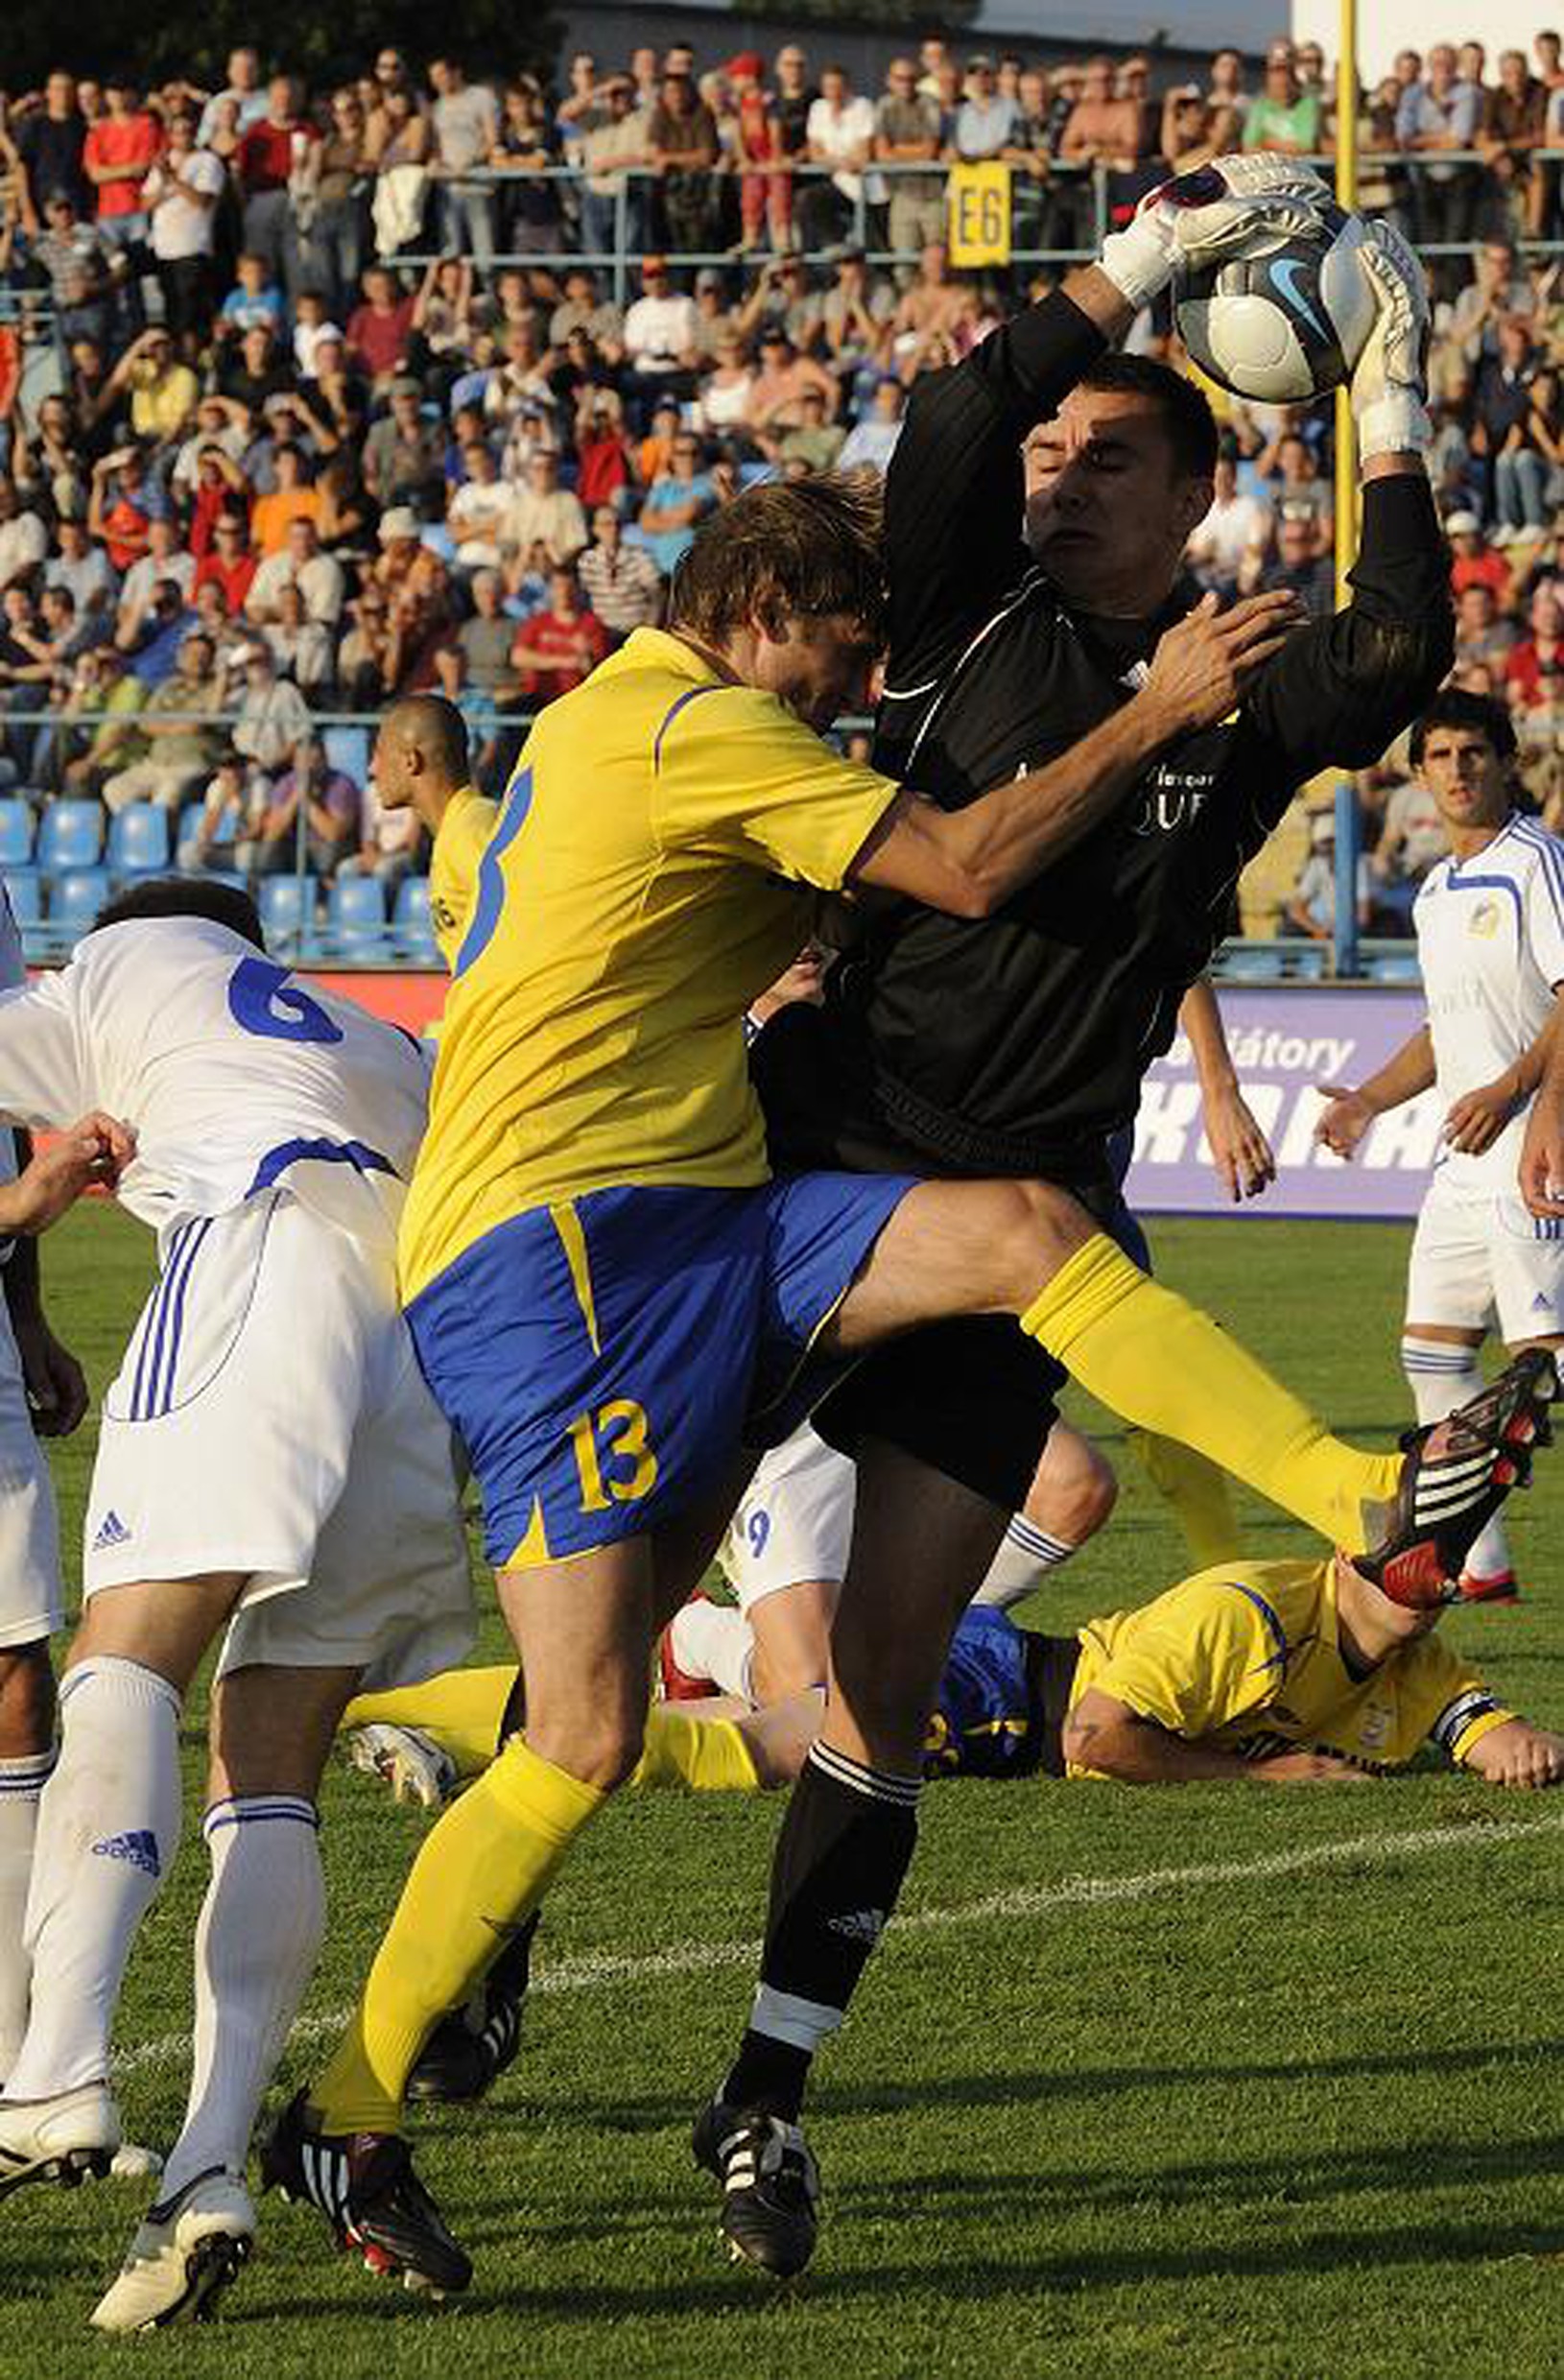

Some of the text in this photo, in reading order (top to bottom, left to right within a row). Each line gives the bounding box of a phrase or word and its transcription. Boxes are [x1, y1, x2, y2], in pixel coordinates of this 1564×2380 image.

[960, 186, 1003, 247] E6
[228, 957, 344, 1043] 6
[565, 1399, 659, 1513] 13
[748, 1510, 770, 1559] 9
